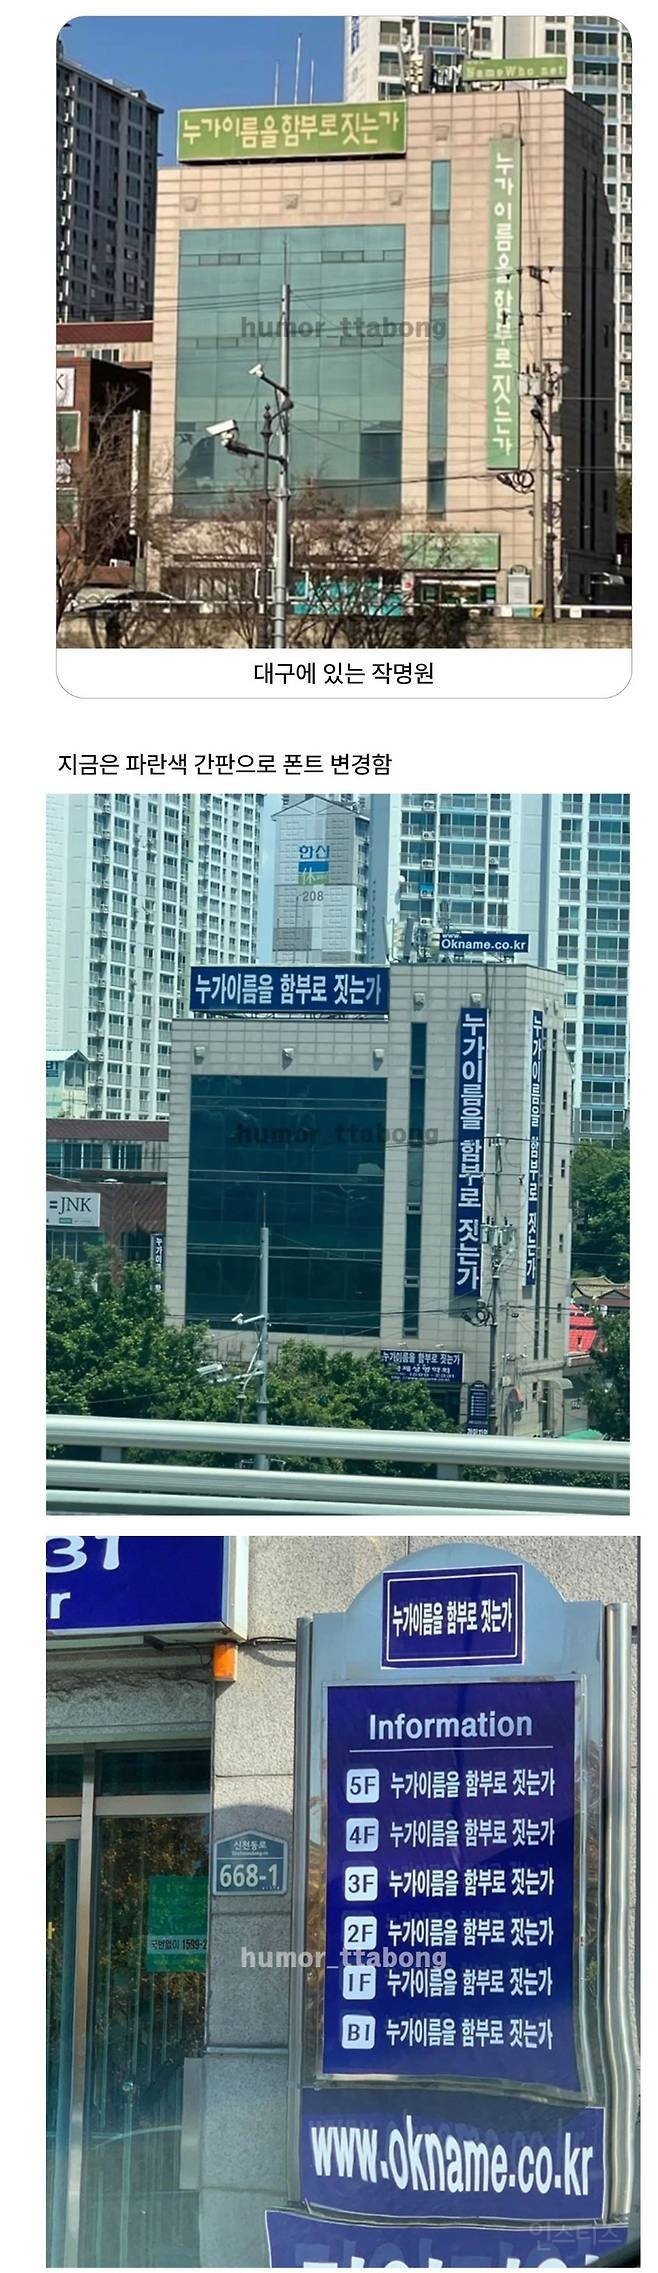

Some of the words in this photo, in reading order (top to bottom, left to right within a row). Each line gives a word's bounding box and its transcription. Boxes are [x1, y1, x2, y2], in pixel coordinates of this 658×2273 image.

[302, 890, 324, 902] 208
[441, 938, 526, 949] Okname.co.kr
[195, 973, 274, 1005] 누가이름을
[280, 973, 327, 1005] 함부로
[333, 973, 382, 1006] 짓는가
[460, 1013, 485, 1130] 누가이름을
[531, 1014, 542, 1127] 누가이름을
[458, 1139, 482, 1208] 함부로
[457, 1219, 480, 1290] 짓는가
[526, 1213, 537, 1280] 짓는가
[440, 1353, 460, 1365] 짓는가
[393, 1602, 443, 1637] 누가이름을
[447, 1600, 478, 1635] 함부로
[481, 1598, 512, 1633] 짓는가
[369, 1711, 532, 1740] Information
[350, 1776, 376, 1795] 5F
[390, 1771, 460, 1799] 누가이름을
[466, 1770, 507, 1797] 함부로
[513, 1768, 555, 1796] 짓는가
[350, 1826, 376, 1845] 4F
[390, 1819, 460, 1848] 누가이름을
[465, 1819, 507, 1847] 함부로
[513, 1818, 555, 1846] 짓는가
[220, 1863, 278, 1888] 668-1
[348, 1873, 375, 1894] 3F
[389, 1869, 459, 1897] 누가이름을
[464, 1869, 506, 1896] 함부로
[512, 1867, 554, 1896] 짓는가
[347, 1924, 374, 1943] 2F
[388, 1918, 458, 1947] 누가이름을
[463, 1918, 505, 1946] 함부로
[510, 1917, 554, 1946] 짓는가
[387, 1968, 458, 1997] 누가이름을
[463, 1969, 505, 1996] 함부로
[510, 1967, 553, 1996] 짓는가
[386, 2018, 456, 2047] 누가이름을
[462, 2018, 504, 2048] 함부로
[510, 2018, 553, 2050] 짓는가
[311, 2115, 593, 2196] www.okname.co.kr
